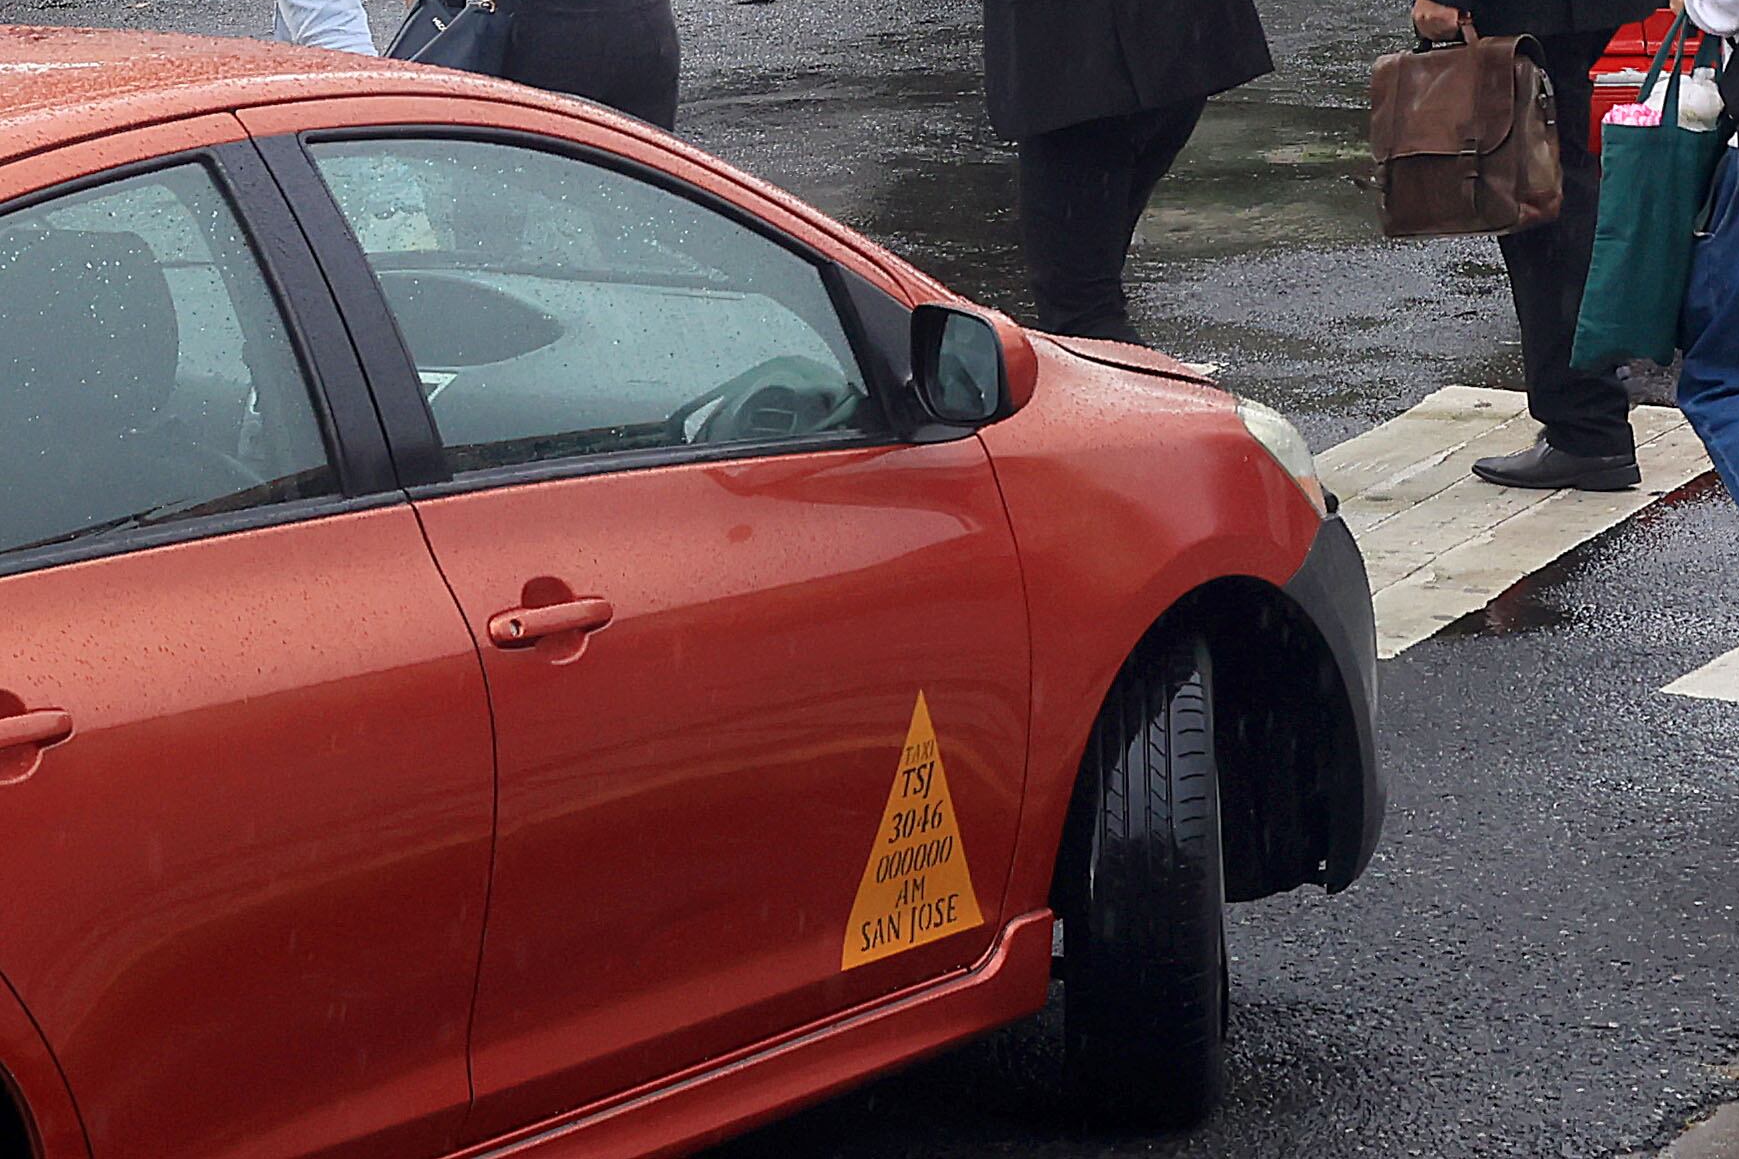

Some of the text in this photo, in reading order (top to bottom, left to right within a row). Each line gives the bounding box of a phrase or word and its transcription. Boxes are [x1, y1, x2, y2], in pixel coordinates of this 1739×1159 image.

[905, 739, 935, 764] TAXI
[902, 760, 935, 798] TSJ
[888, 799, 943, 844] 3046
[875, 835, 953, 883] 000000
[895, 875, 925, 909] AM
[861, 893, 959, 952] SAN JOSE
